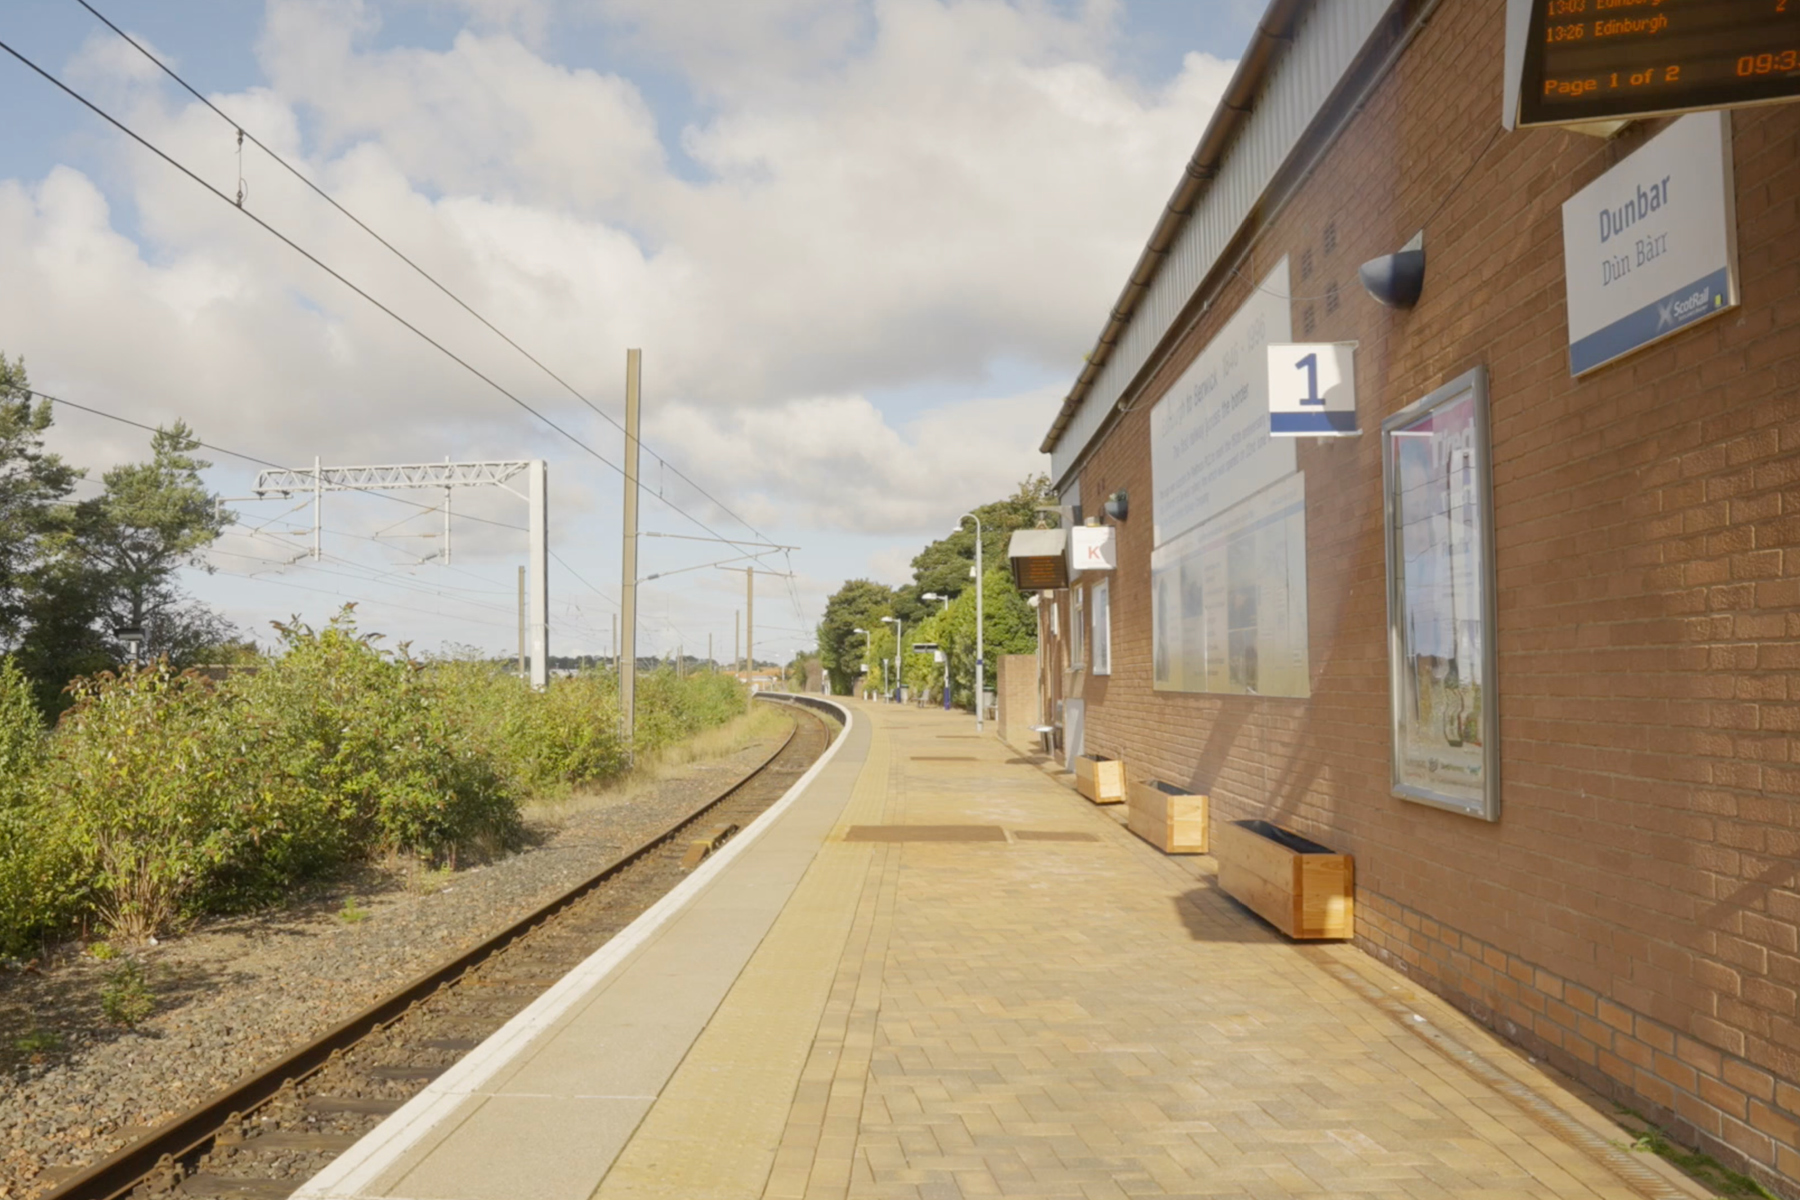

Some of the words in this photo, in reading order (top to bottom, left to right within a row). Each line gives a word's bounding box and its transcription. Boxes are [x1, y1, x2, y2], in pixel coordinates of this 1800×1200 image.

[1546, 23, 1585, 43] 13:26
[1594, 13, 1668, 36] Edinburgh
[1775, 0, 1786, 12] 2
[1544, 79, 1597, 97] Page
[1609, 72, 1618, 88] 1
[1630, 68, 1654, 86] of
[1665, 65, 1680, 82] 2
[1736, 49, 1800, 77] 09:3
[1599, 174, 1670, 243] Dunbar
[1602, 253, 1631, 286] Dùn
[1635, 231, 1669, 268] Bàrr
[1673, 286, 1710, 318] ScotRail
[1194, 368, 1218, 407] Berwick
[1295, 353, 1326, 405] 1
[1088, 546, 1100, 559] K
